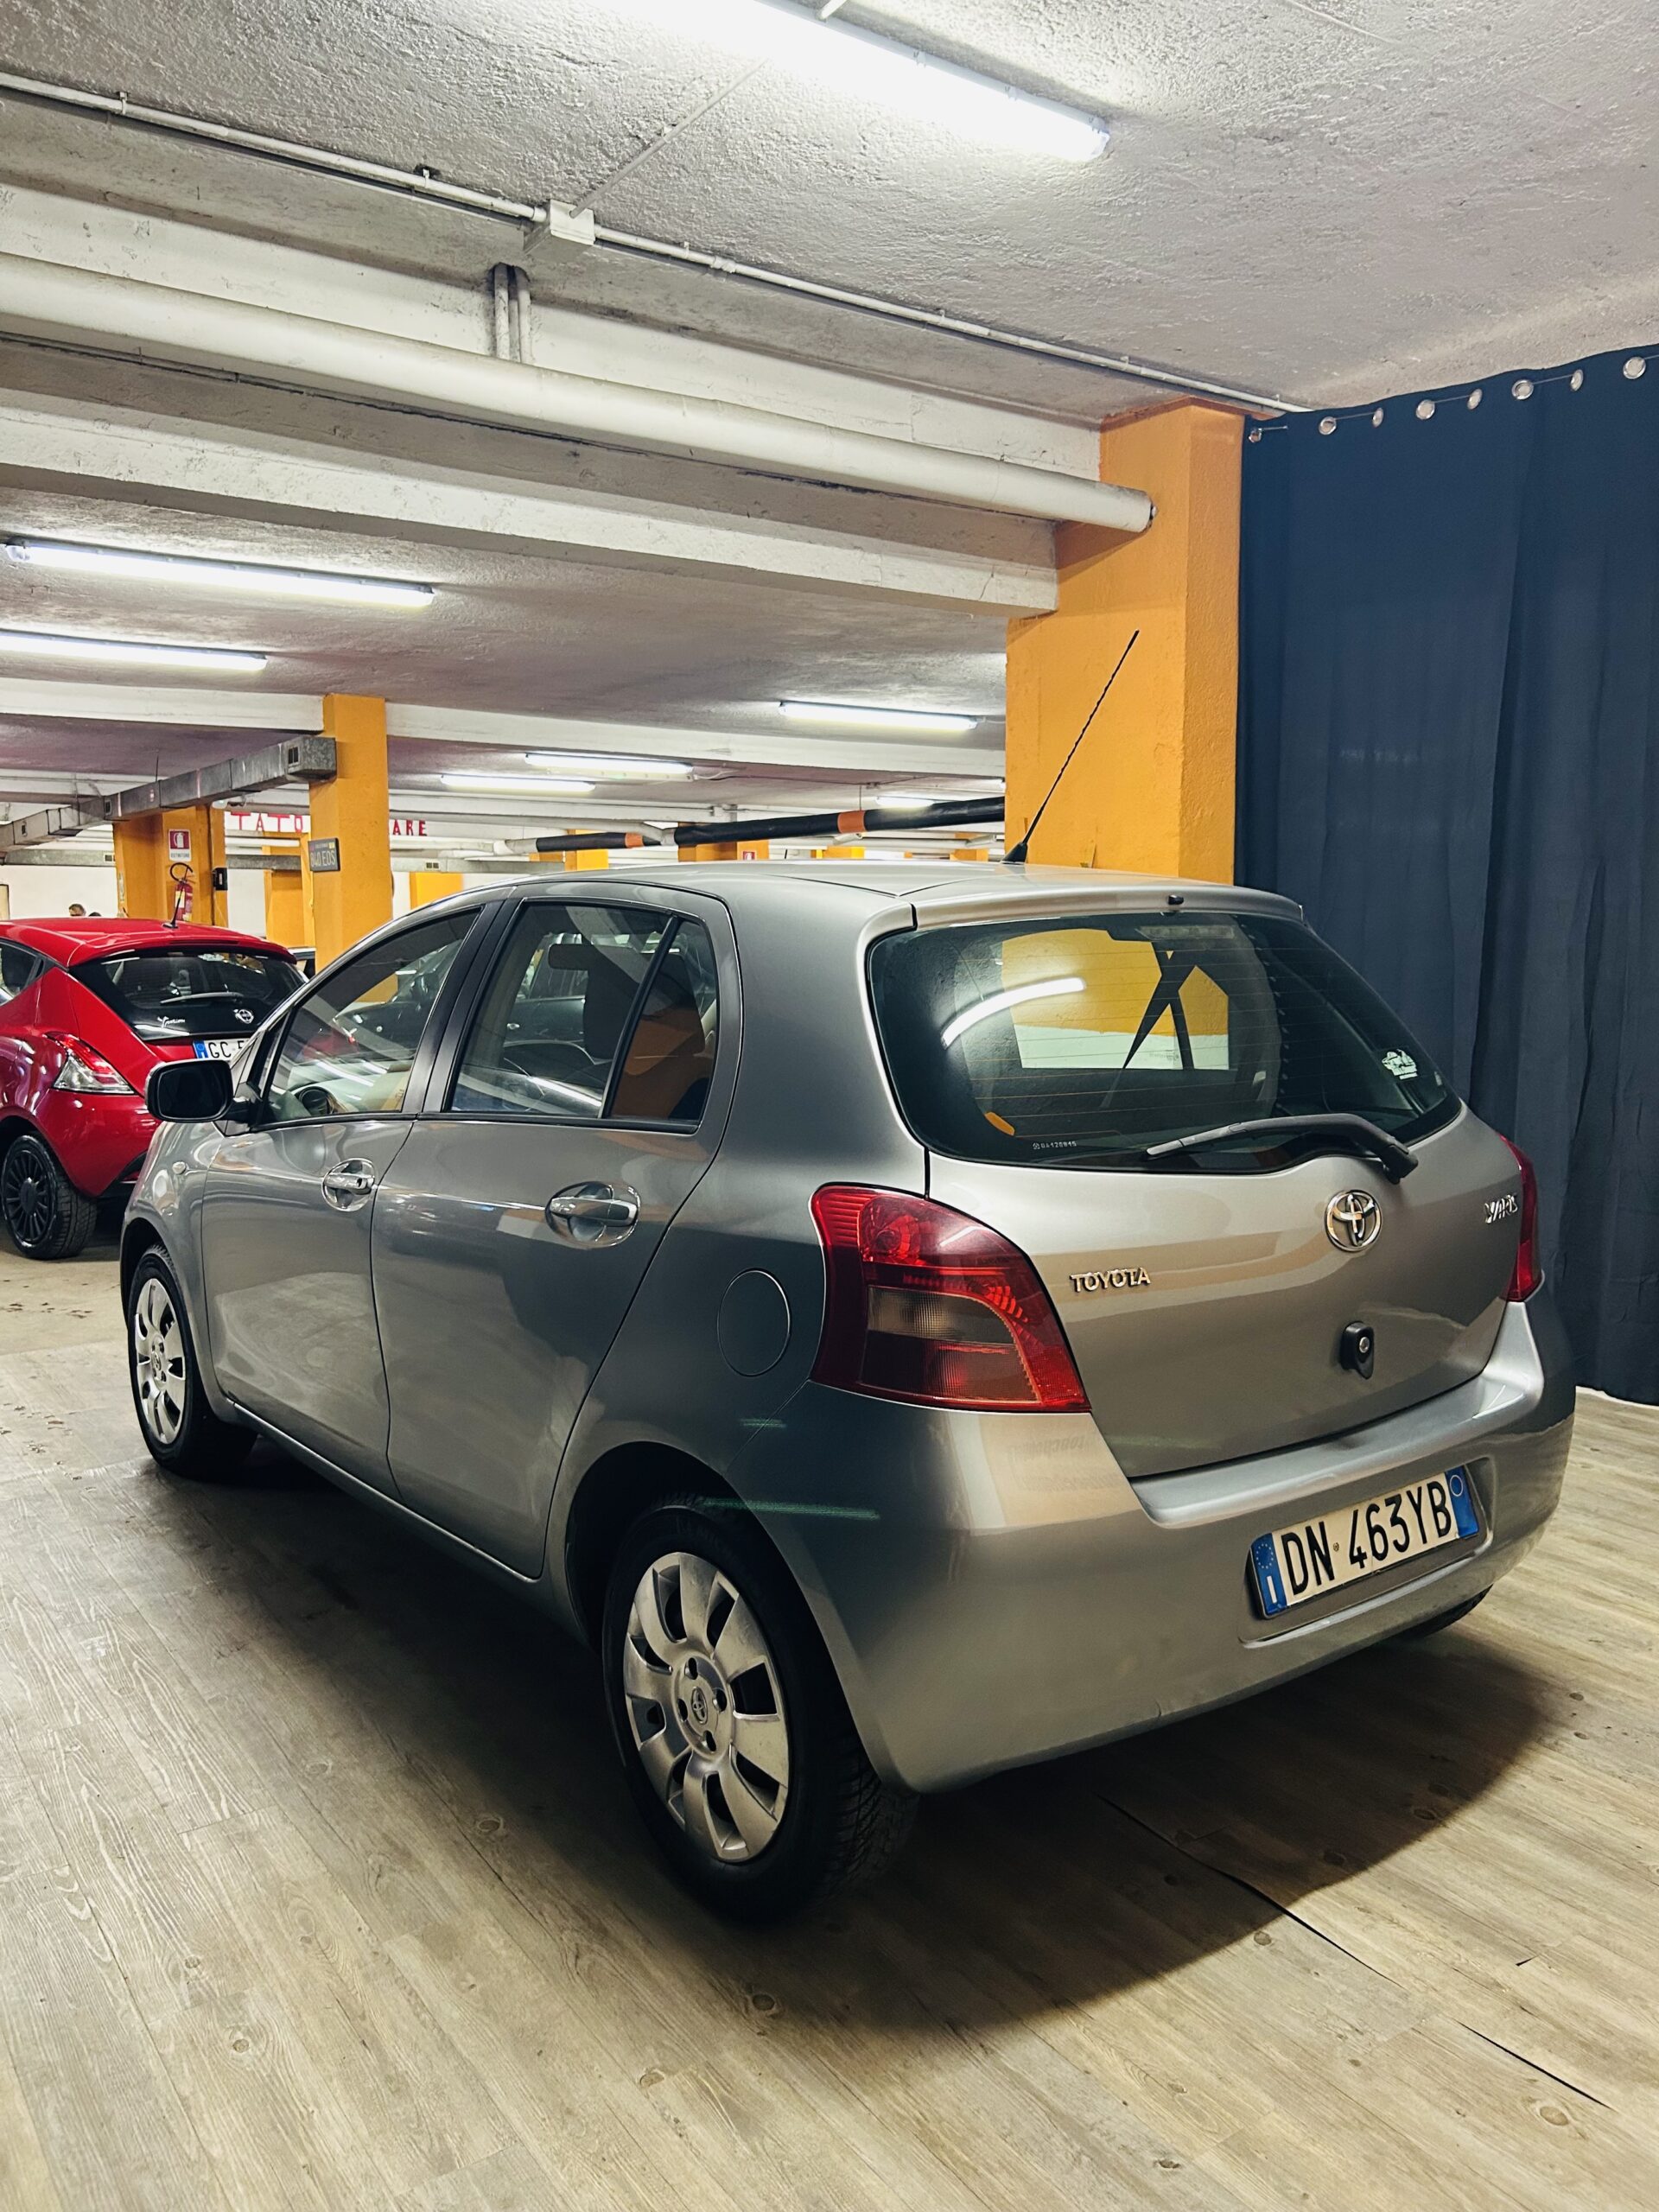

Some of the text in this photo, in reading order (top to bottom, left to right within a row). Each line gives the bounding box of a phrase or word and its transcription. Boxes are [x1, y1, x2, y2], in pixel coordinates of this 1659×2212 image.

[1069, 1267, 1151, 1293] TOYOTA
[1281, 1521, 1335, 1596] DN
[1349, 1481, 1452, 1569] 463YB
